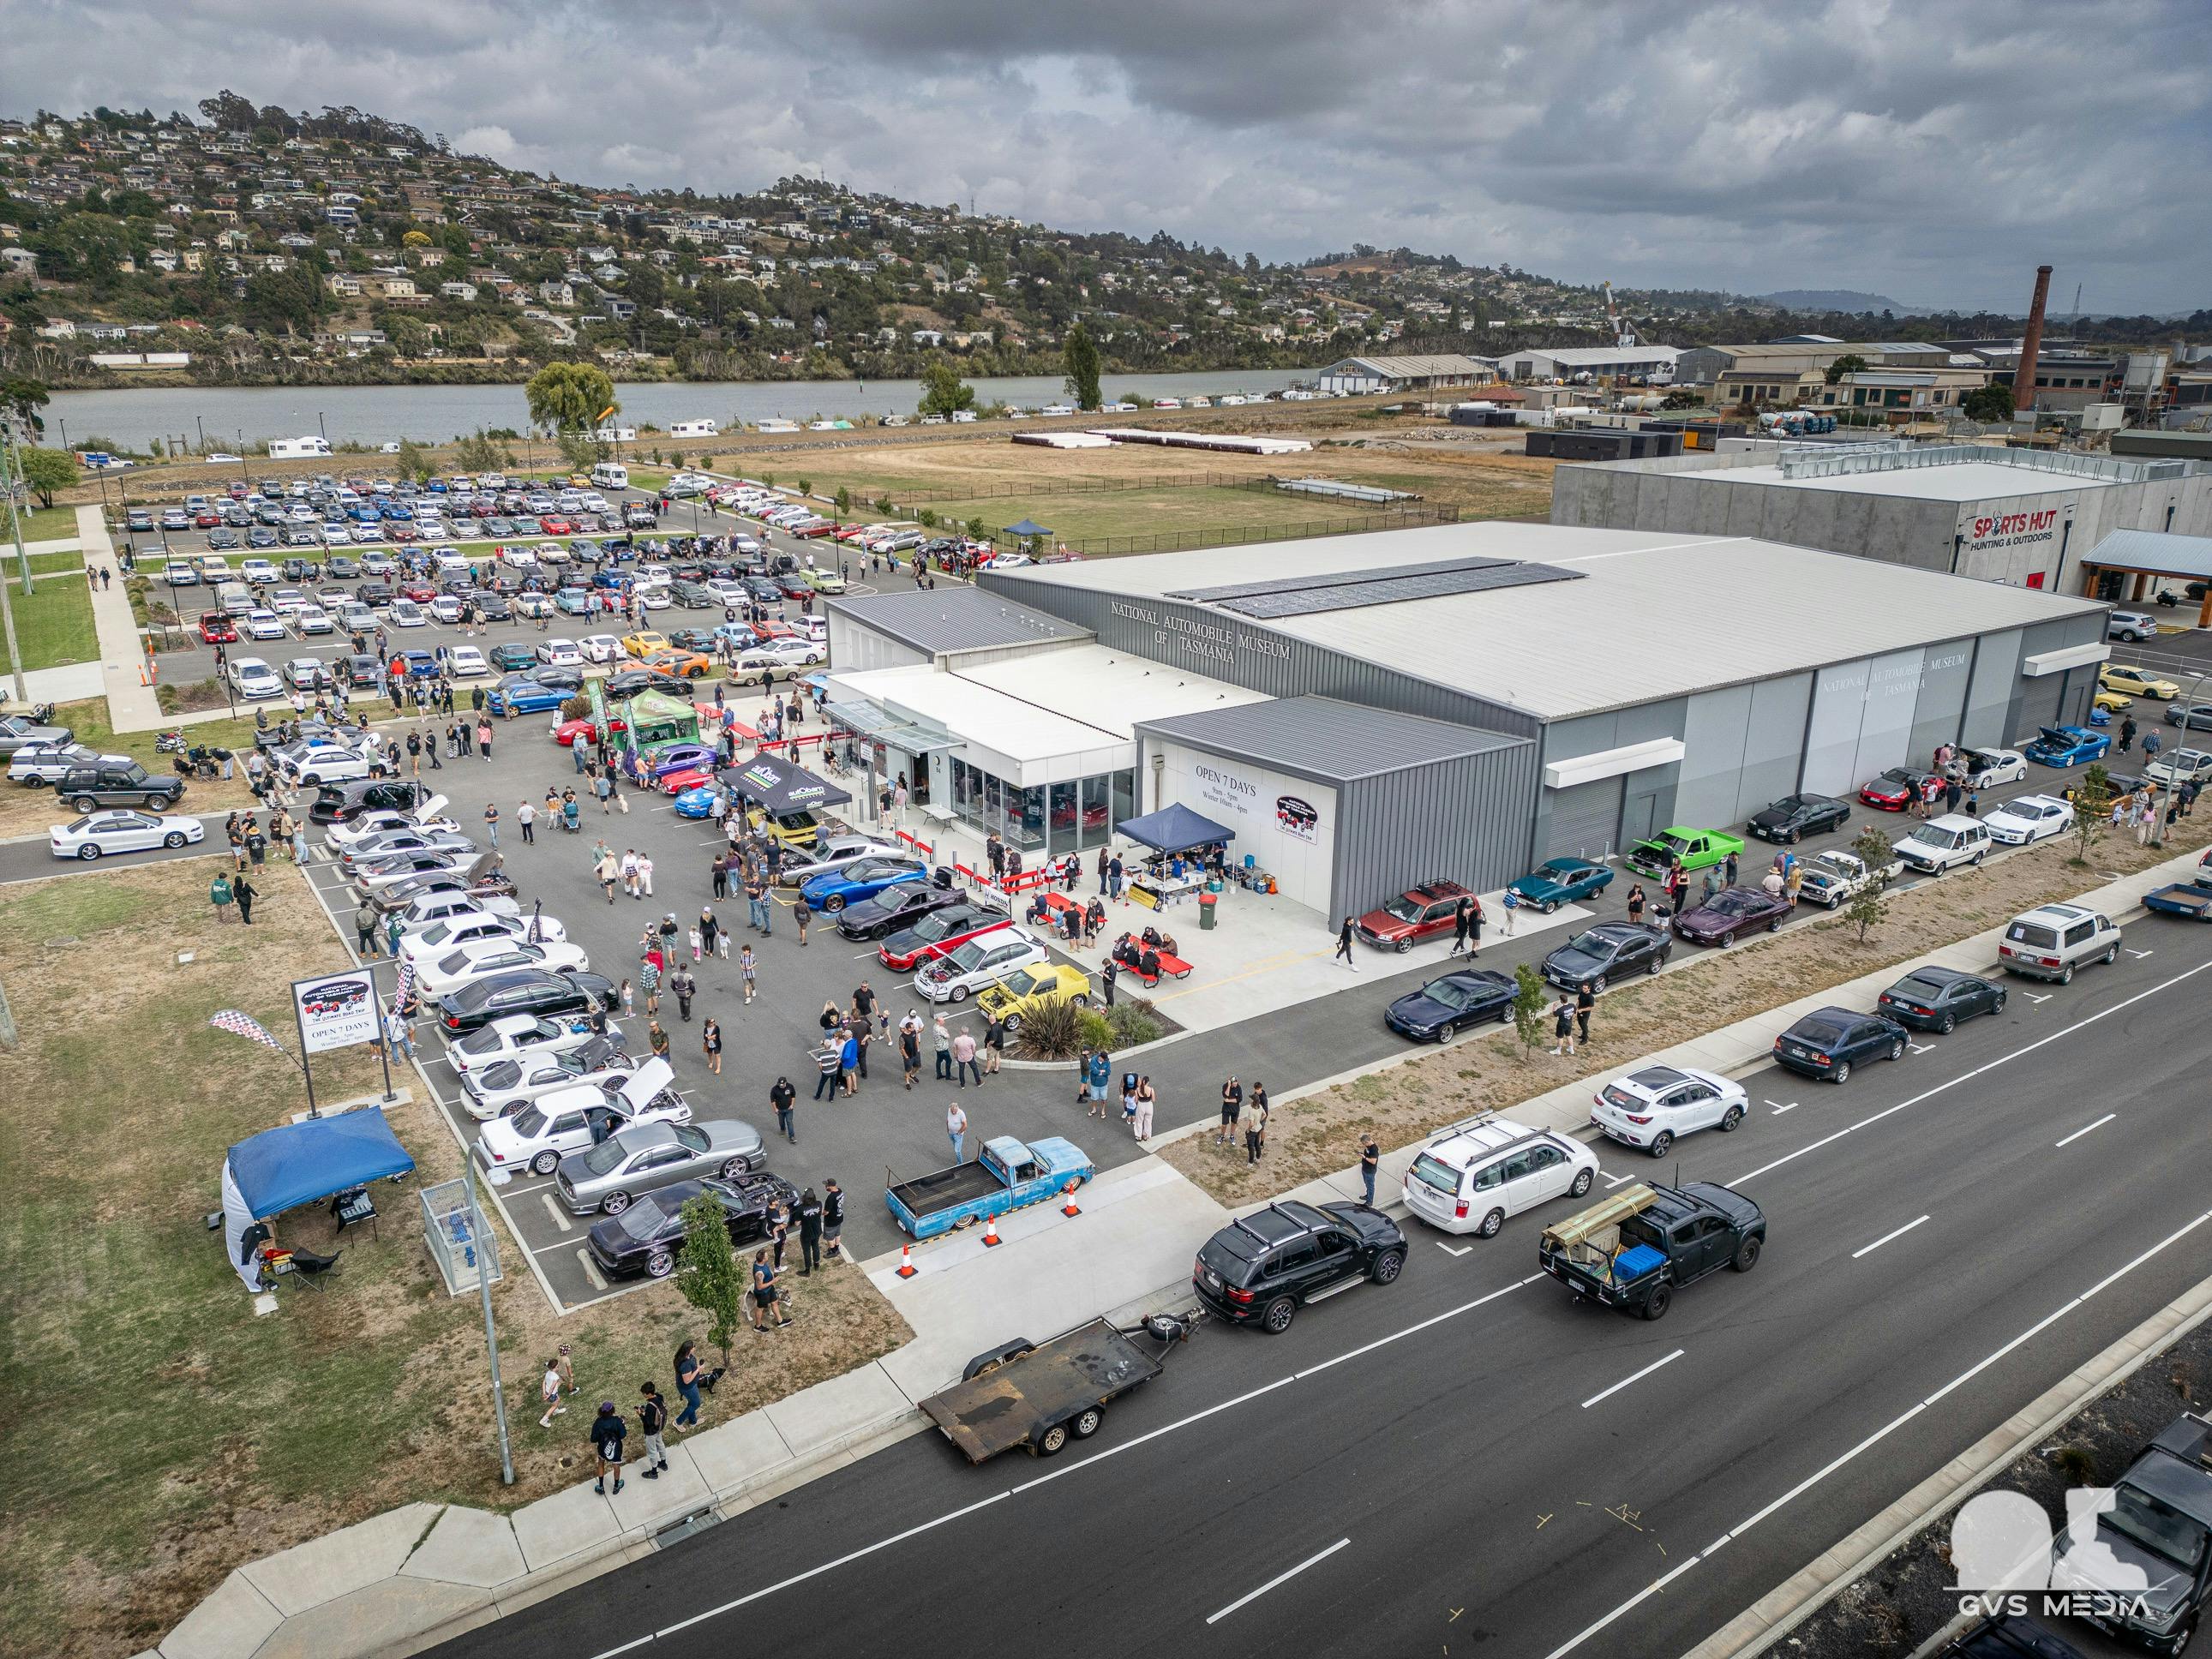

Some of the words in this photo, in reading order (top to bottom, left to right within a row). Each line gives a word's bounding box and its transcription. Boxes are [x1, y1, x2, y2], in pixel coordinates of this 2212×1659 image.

[1974, 510, 2027, 538] SPORTS
[2029, 510, 2057, 531] HUT
[1971, 538, 2004, 551] HUNTING
[2014, 532, 2053, 545] OUTDOORS
[1111, 602, 1159, 625] NATIONAL
[1164, 616, 1232, 644] AUTOMOBILE
[1239, 634, 1290, 659] MUSEUM
[1155, 630, 1167, 644] OF
[1180, 637, 1234, 664] TASMANIA
[1823, 674, 1865, 693] NATIONAL
[1871, 662, 1926, 683] AUTOMOBILE
[1930, 653, 1966, 671] MUSEUM
[1861, 690, 1872, 701] OF
[1885, 679, 1925, 697] TASMANIA
[1196, 765, 1220, 784] OPEN
[1223, 775, 1228, 786] 7
[1229, 778, 1256, 797] DAYS
[1203, 791, 1218, 802] Winter
[1220, 797, 1232, 808] 10am
[1237, 805, 1247, 814] 4pm
[1212, 786, 1223, 797] 9am
[1227, 792, 1238, 802] 5pm
[304, 989, 340, 998] AUTOMOBILE
[320, 983, 348, 991] NATIONAL
[312, 1028, 336, 1038] OPEN
[346, 1021, 369, 1032] DAYS
